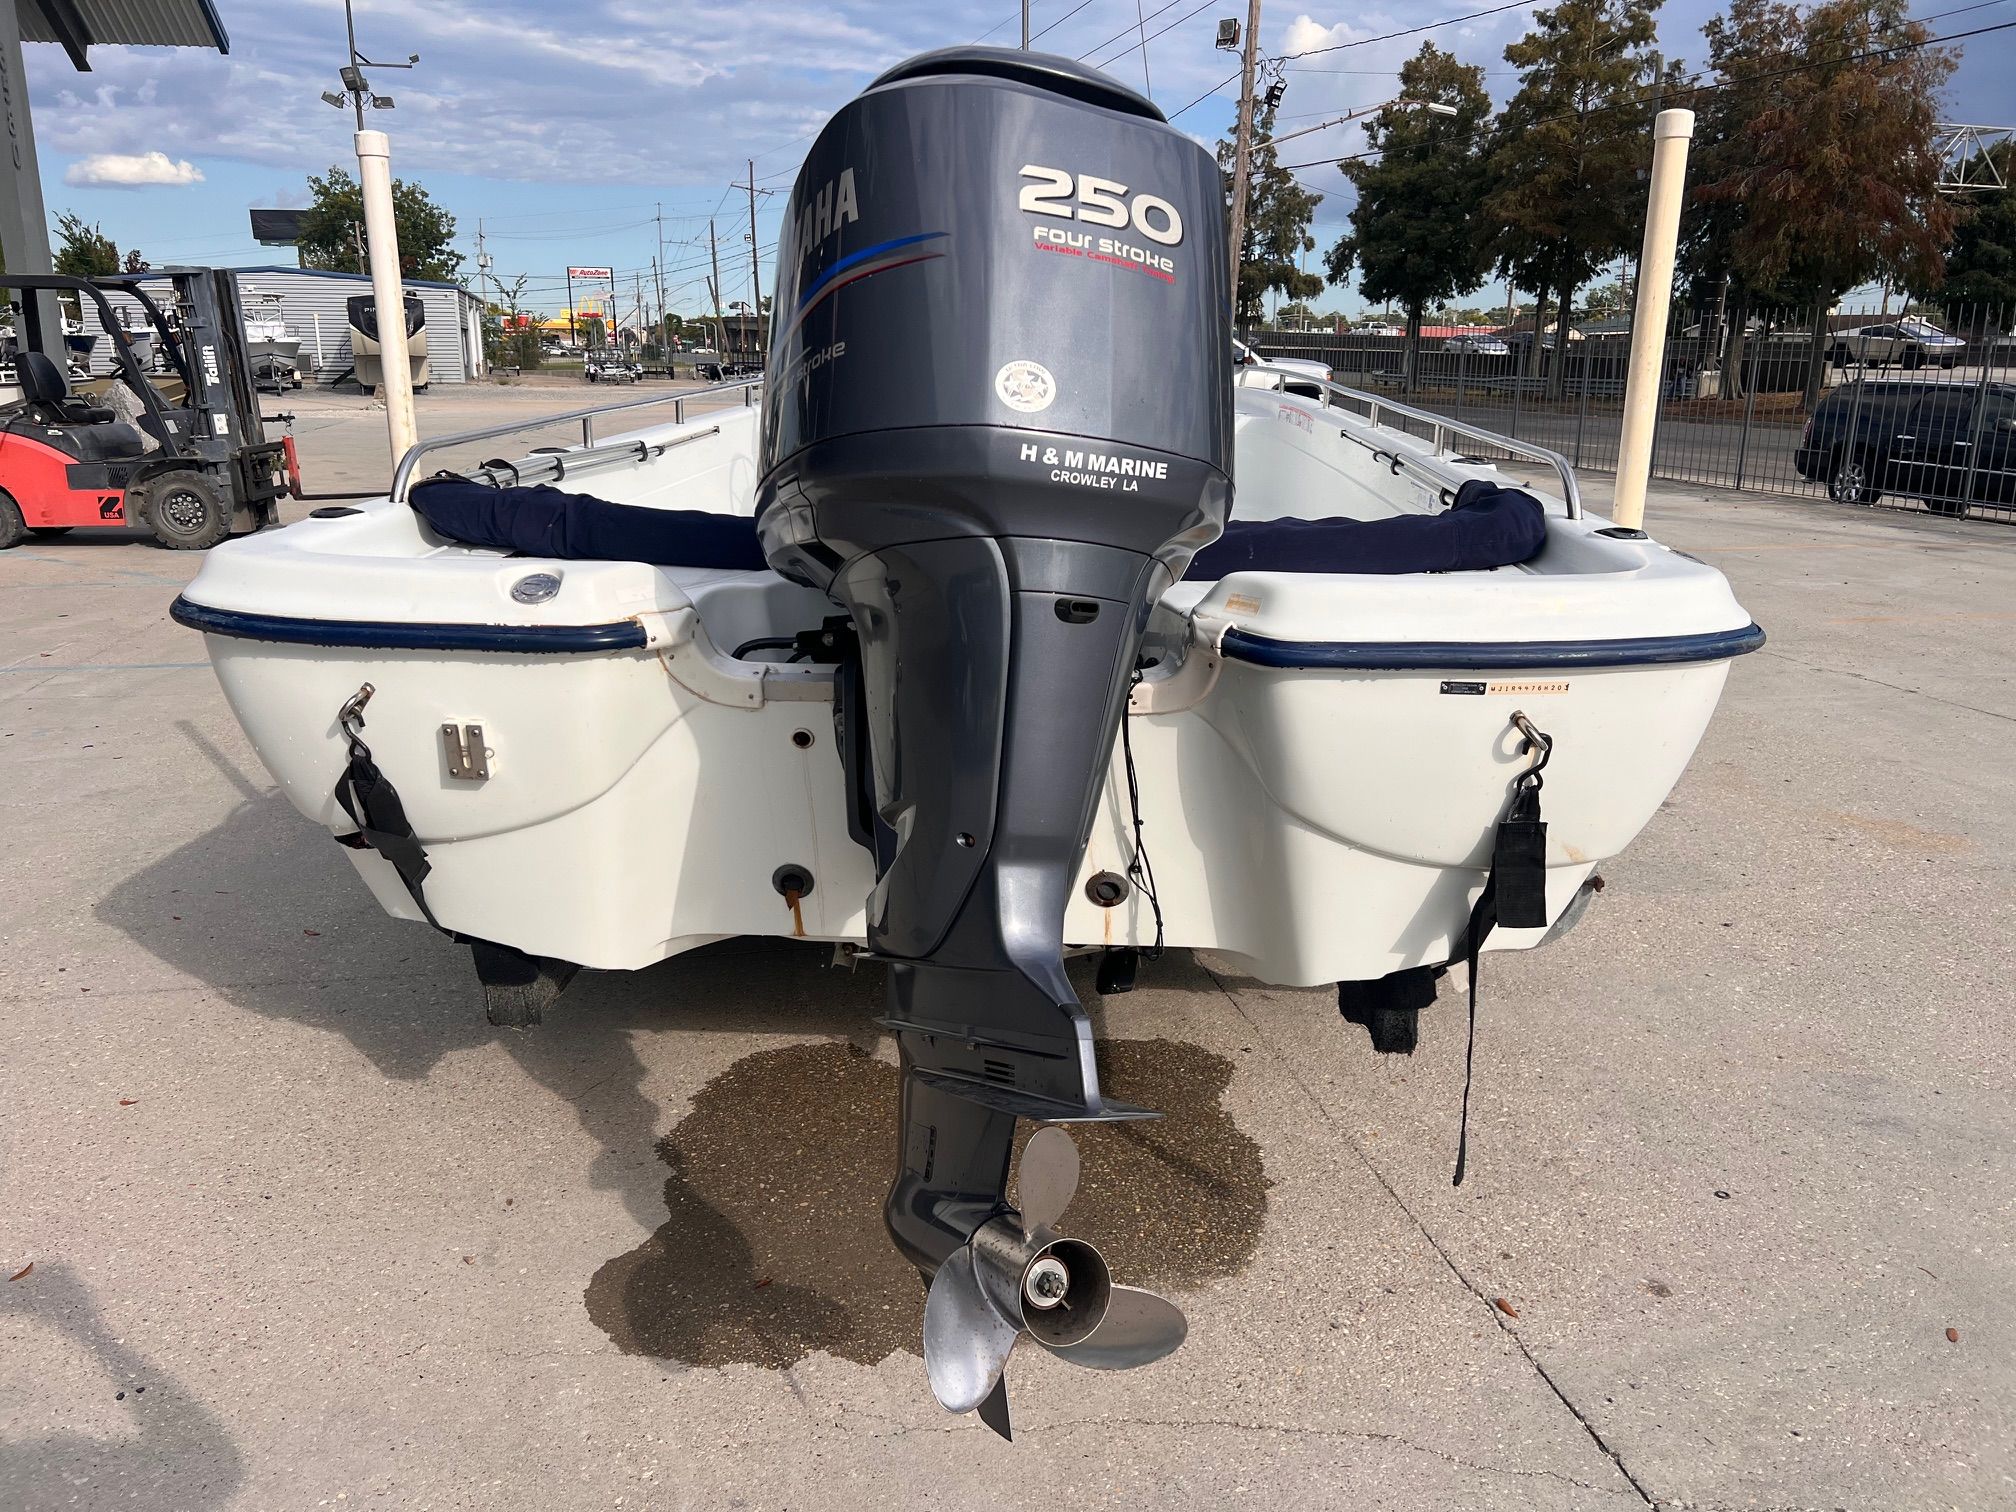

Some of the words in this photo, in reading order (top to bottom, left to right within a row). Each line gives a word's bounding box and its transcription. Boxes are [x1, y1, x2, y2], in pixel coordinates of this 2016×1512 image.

[1018, 164, 1184, 247] 250
[1034, 241, 1083, 257] Variable
[1087, 251, 1139, 271] Camshaft
[202, 345, 220, 387] Tailift
[1020, 443, 1038, 462] H
[1042, 447, 1059, 465] &
[1064, 450, 1084, 469] M
[1087, 453, 1168, 479] MARINE
[1050, 469, 1118, 489] CROWLEY
[1122, 479, 1139, 491] LA
[104, 511, 120, 519] USA
